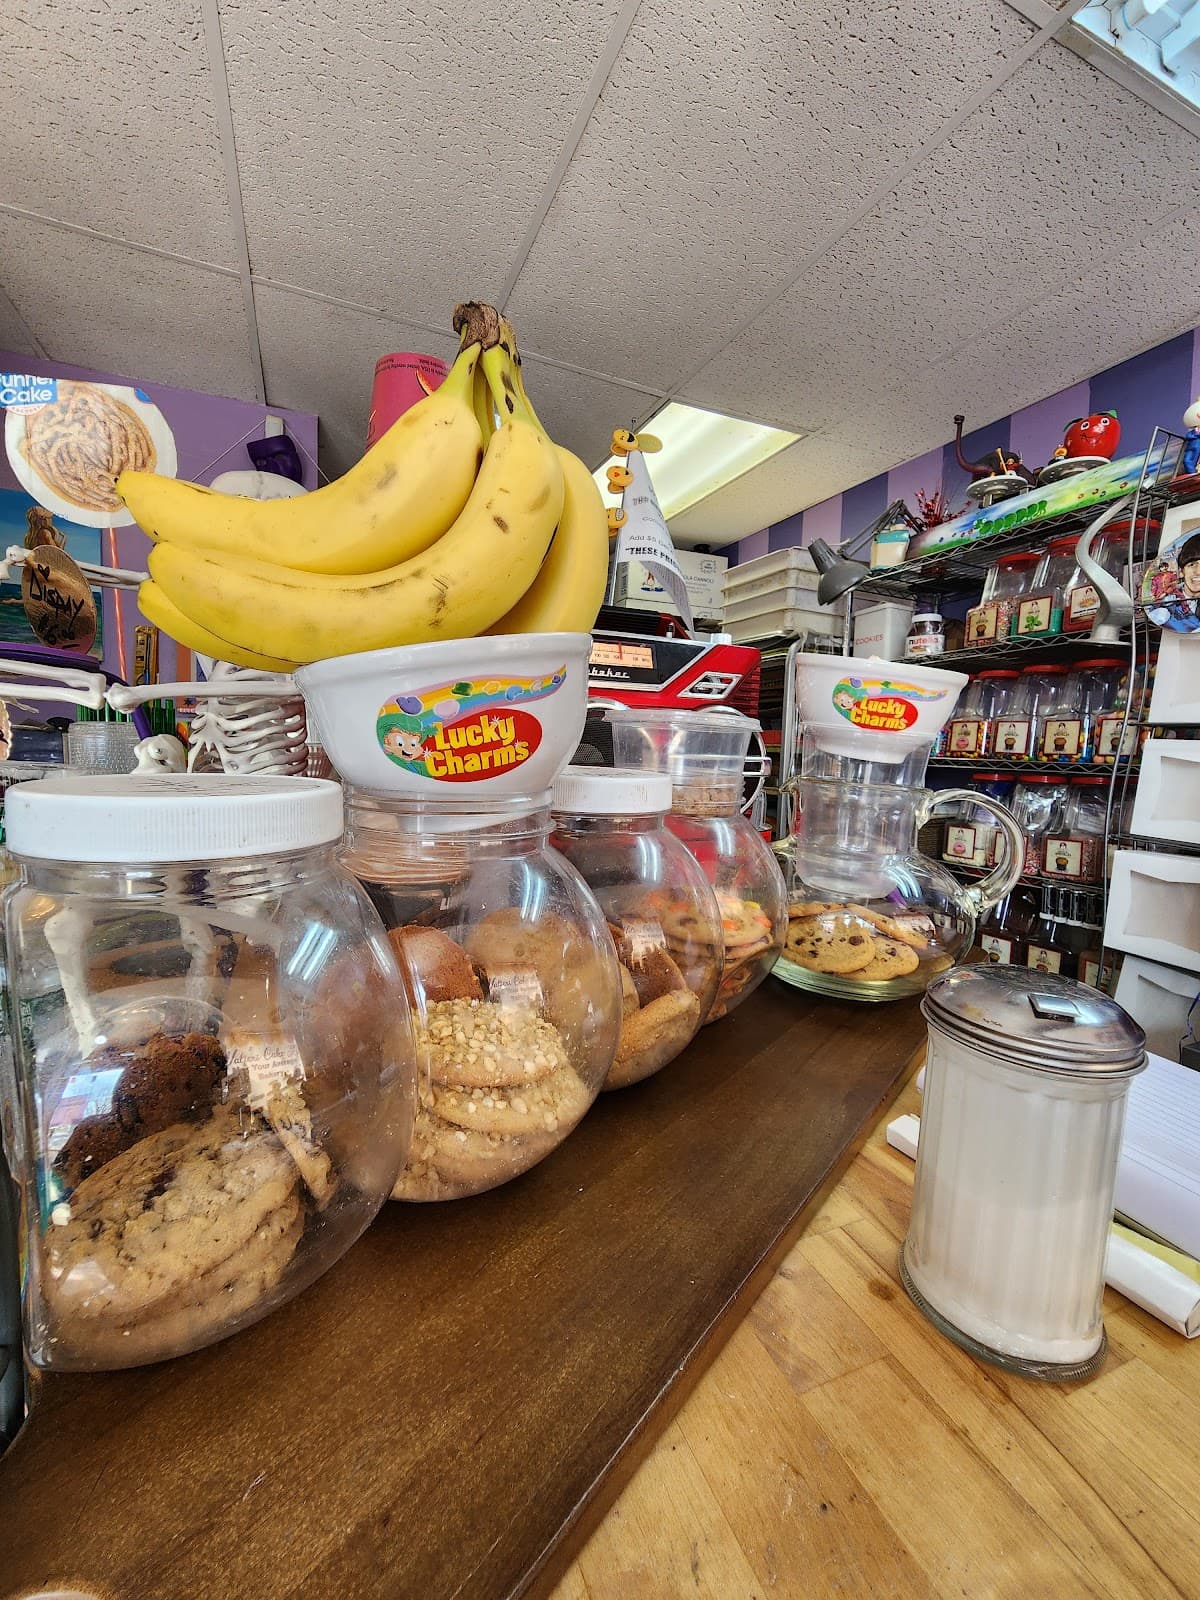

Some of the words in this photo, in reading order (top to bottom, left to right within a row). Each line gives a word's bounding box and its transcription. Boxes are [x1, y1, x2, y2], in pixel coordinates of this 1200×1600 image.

[0, 386, 53, 405] Cake
[629, 547, 658, 557] THESE
[855, 633, 885, 646] COOKIES
[909, 637, 939, 646] nutella
[588, 667, 631, 679] baker
[860, 695, 907, 719] Lucky
[850, 707, 908, 730] Charms
[433, 714, 516, 750] Lucky
[425, 740, 530, 777] Charms
